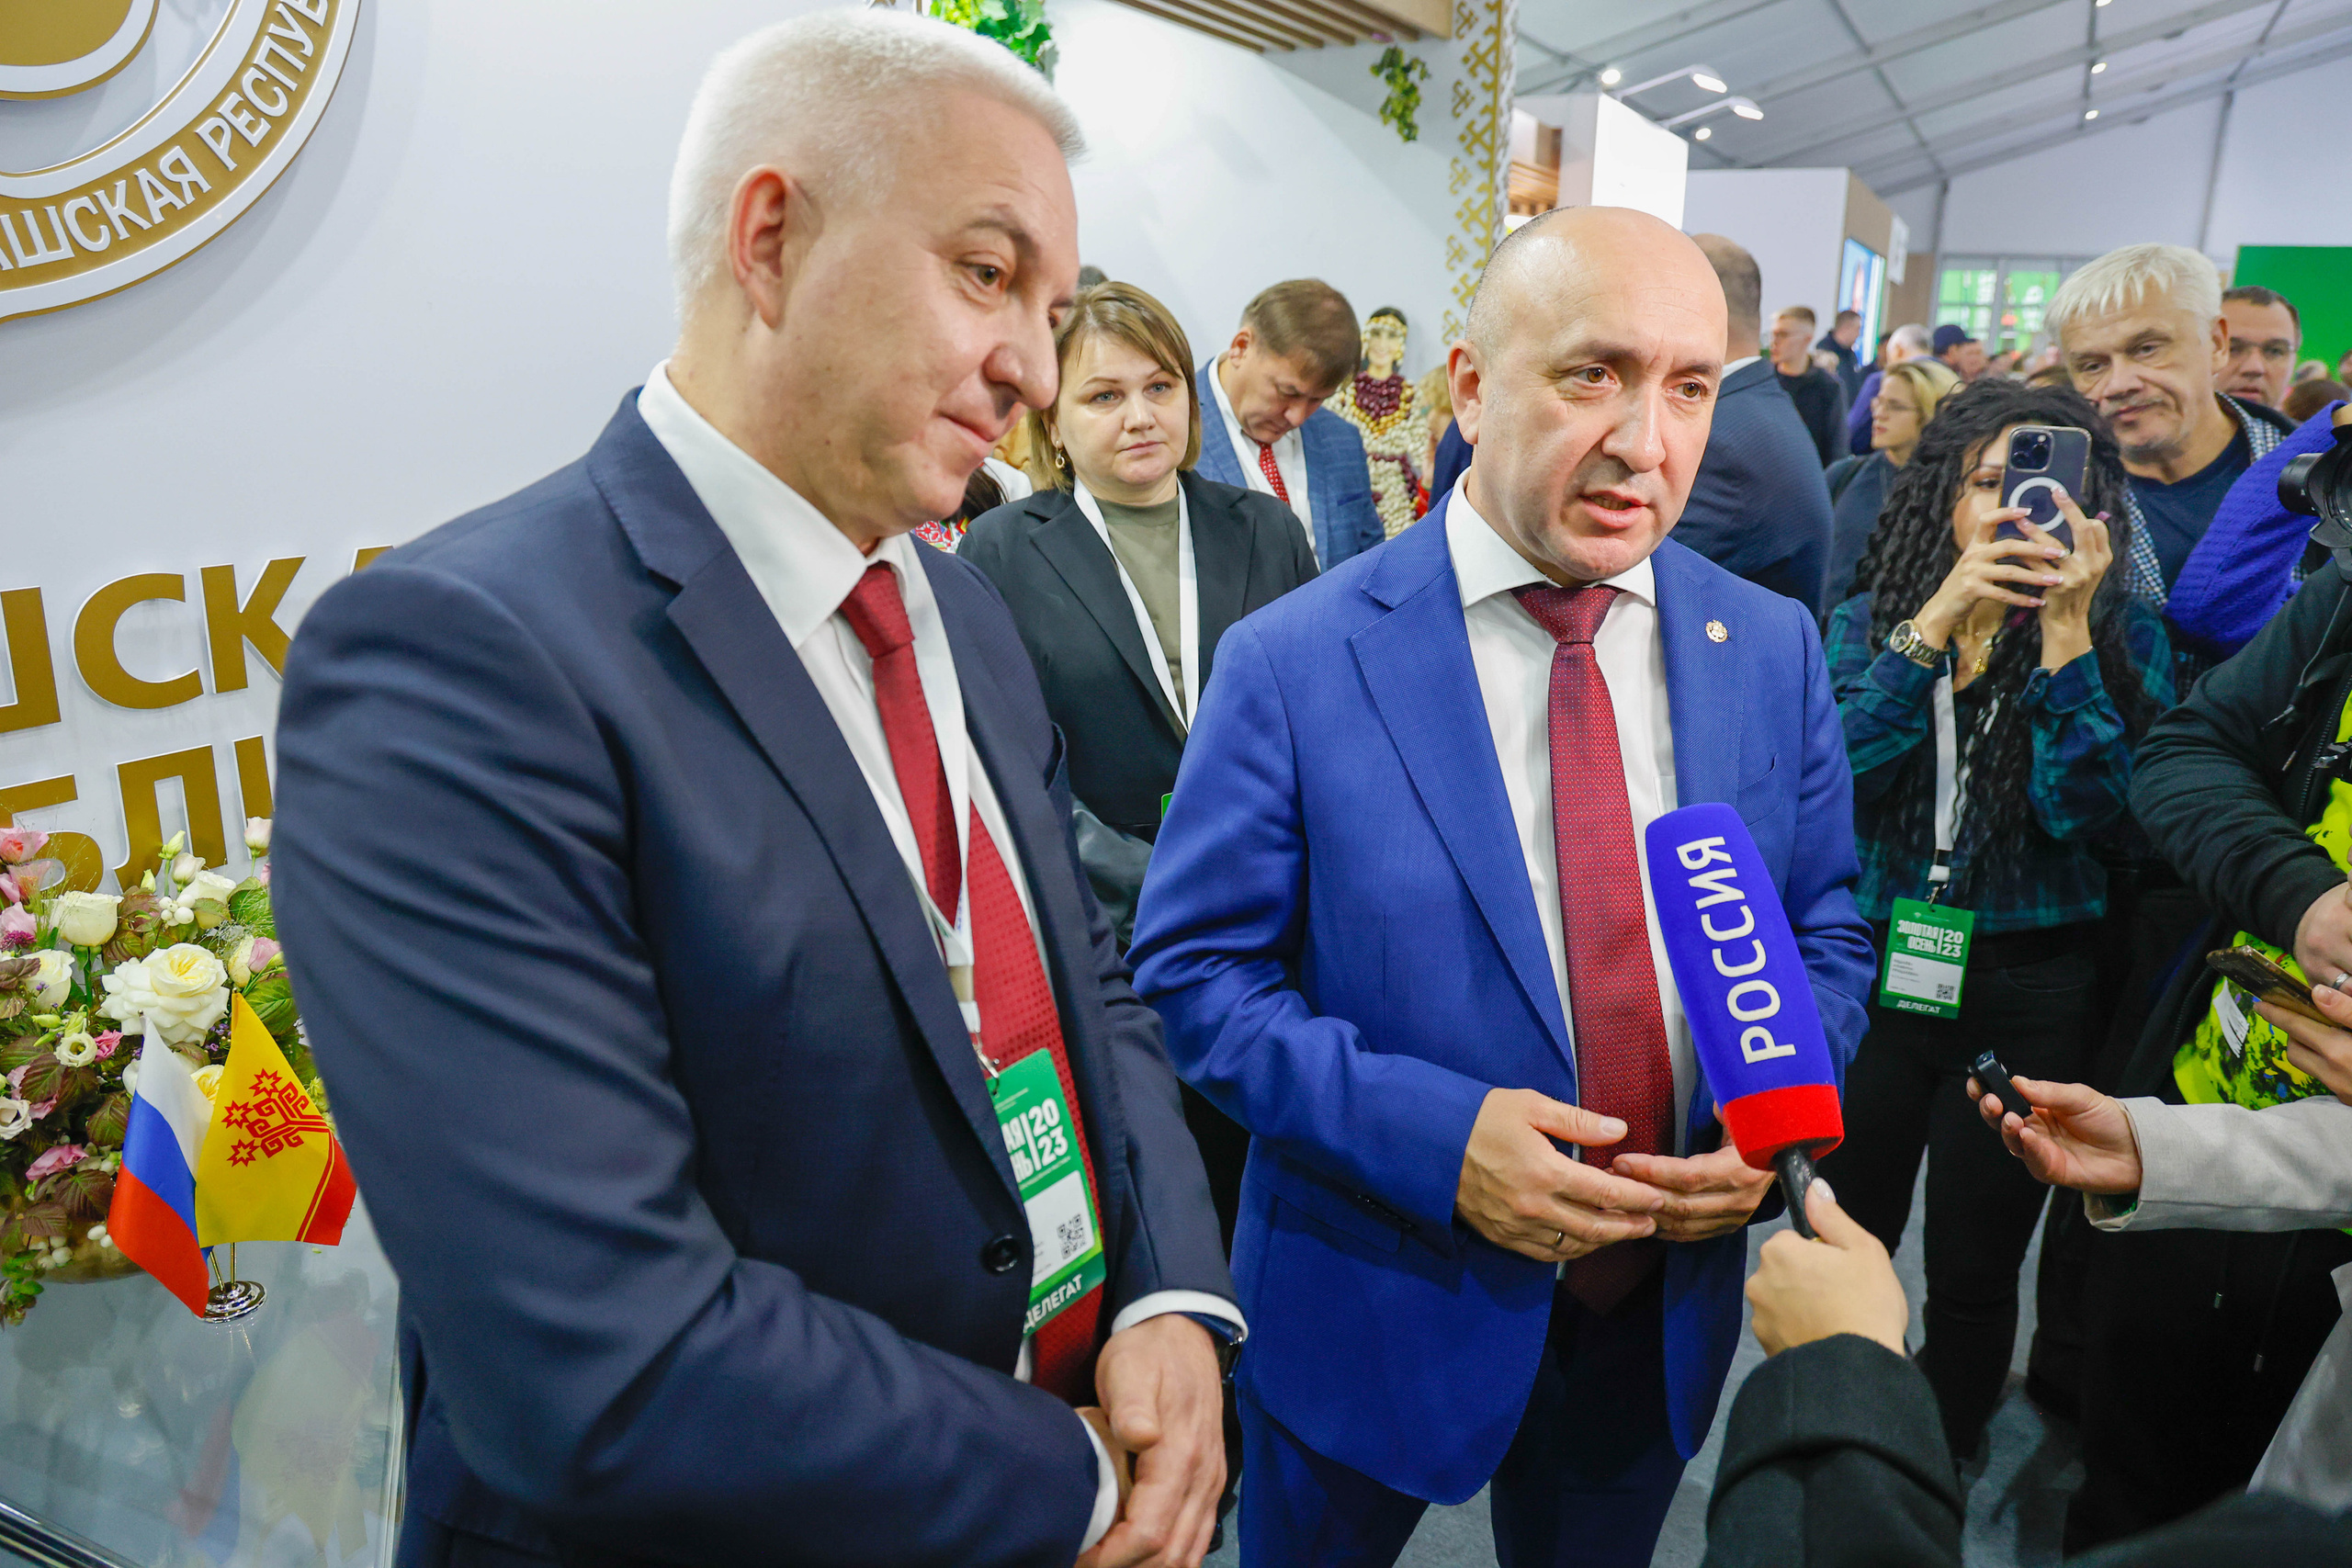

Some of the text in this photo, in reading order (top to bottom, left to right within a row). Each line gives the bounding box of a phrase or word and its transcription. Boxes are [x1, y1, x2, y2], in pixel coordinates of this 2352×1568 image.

[0, 545, 395, 733] СК
[1676, 836, 1797, 1065] РОССИЯ
[1941, 942, 1962, 958] 23
[1943, 929, 1964, 944] 20
[1896, 999, 1941, 1014] ДЕЛЕГАТ
[1028, 1098, 1060, 1137] 20
[1037, 1124, 1069, 1167] 23
